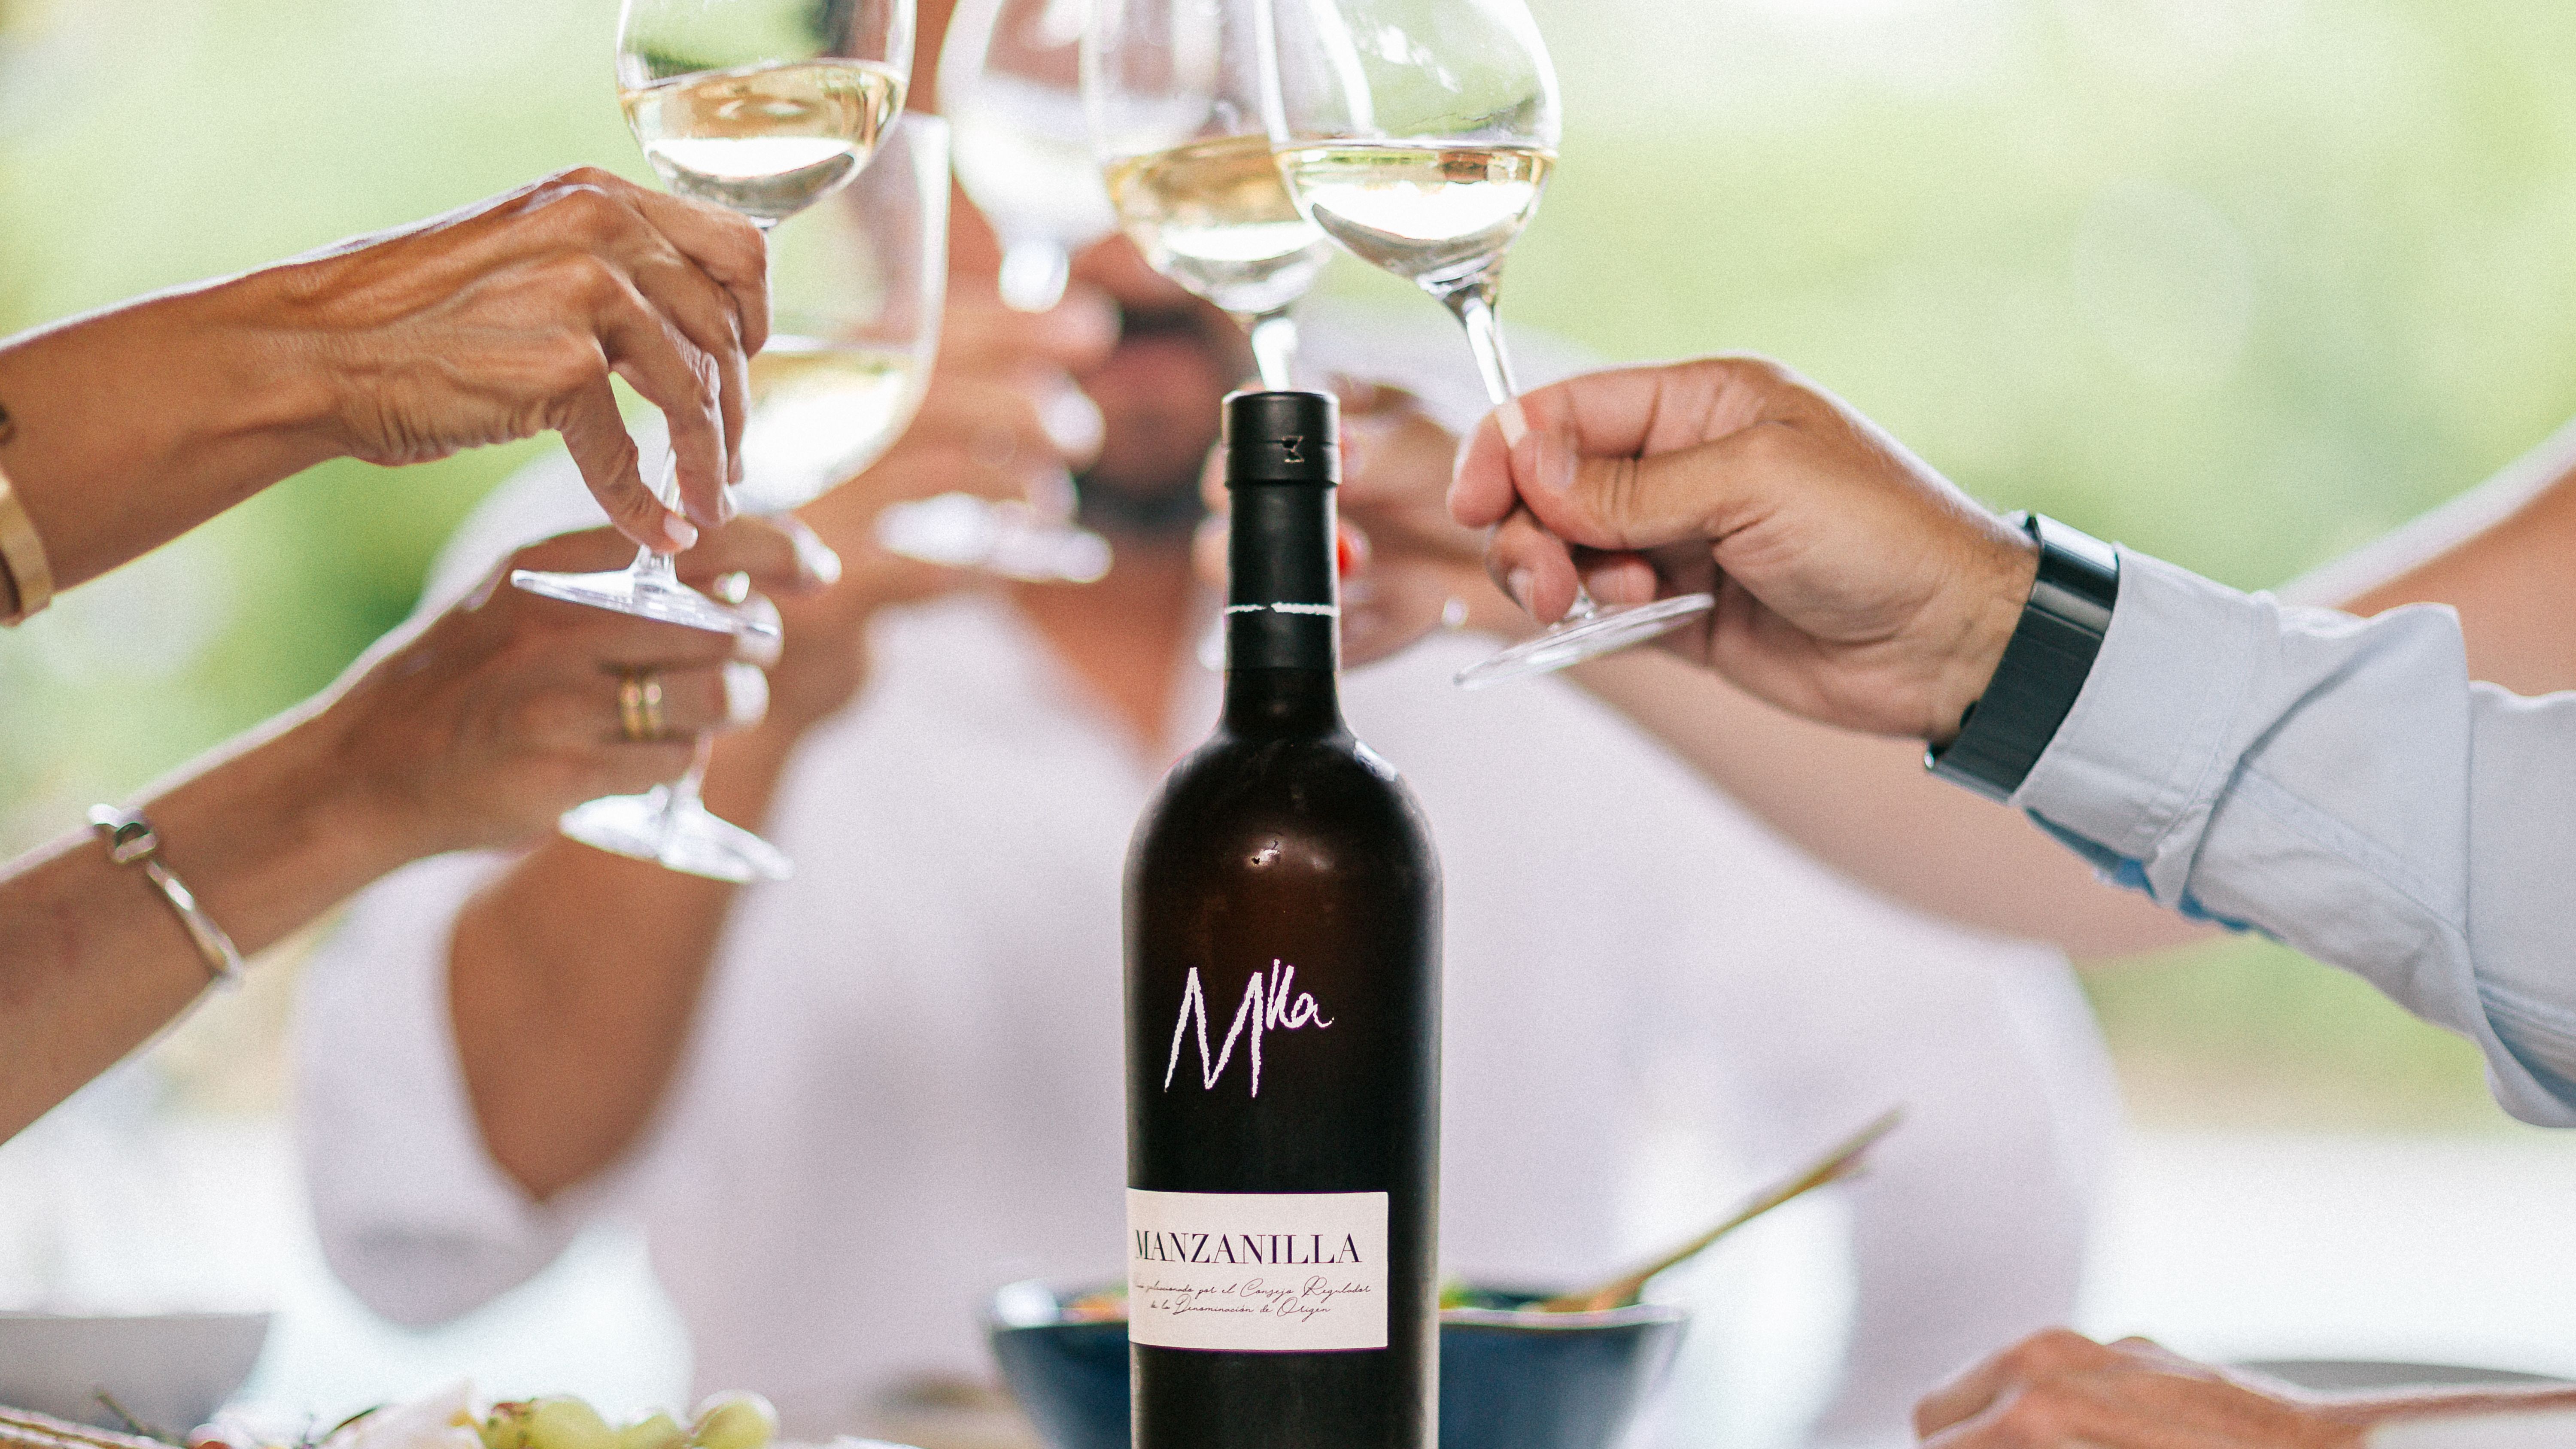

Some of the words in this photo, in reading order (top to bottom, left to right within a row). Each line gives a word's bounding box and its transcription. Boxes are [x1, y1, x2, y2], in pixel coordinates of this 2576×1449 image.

[1136, 1230, 1362, 1264] MANZANILLA
[1195, 1287, 1217, 1299] por
[1222, 1283, 1237, 1294] el
[1240, 1278, 1294, 1303] Consejo
[1301, 1275, 1371, 1303] Regulador
[1161, 1299, 1171, 1309] la
[1173, 1294, 1254, 1315] Denominación
[1260, 1304, 1273, 1313] de
[1276, 1297, 1331, 1322] Origen
